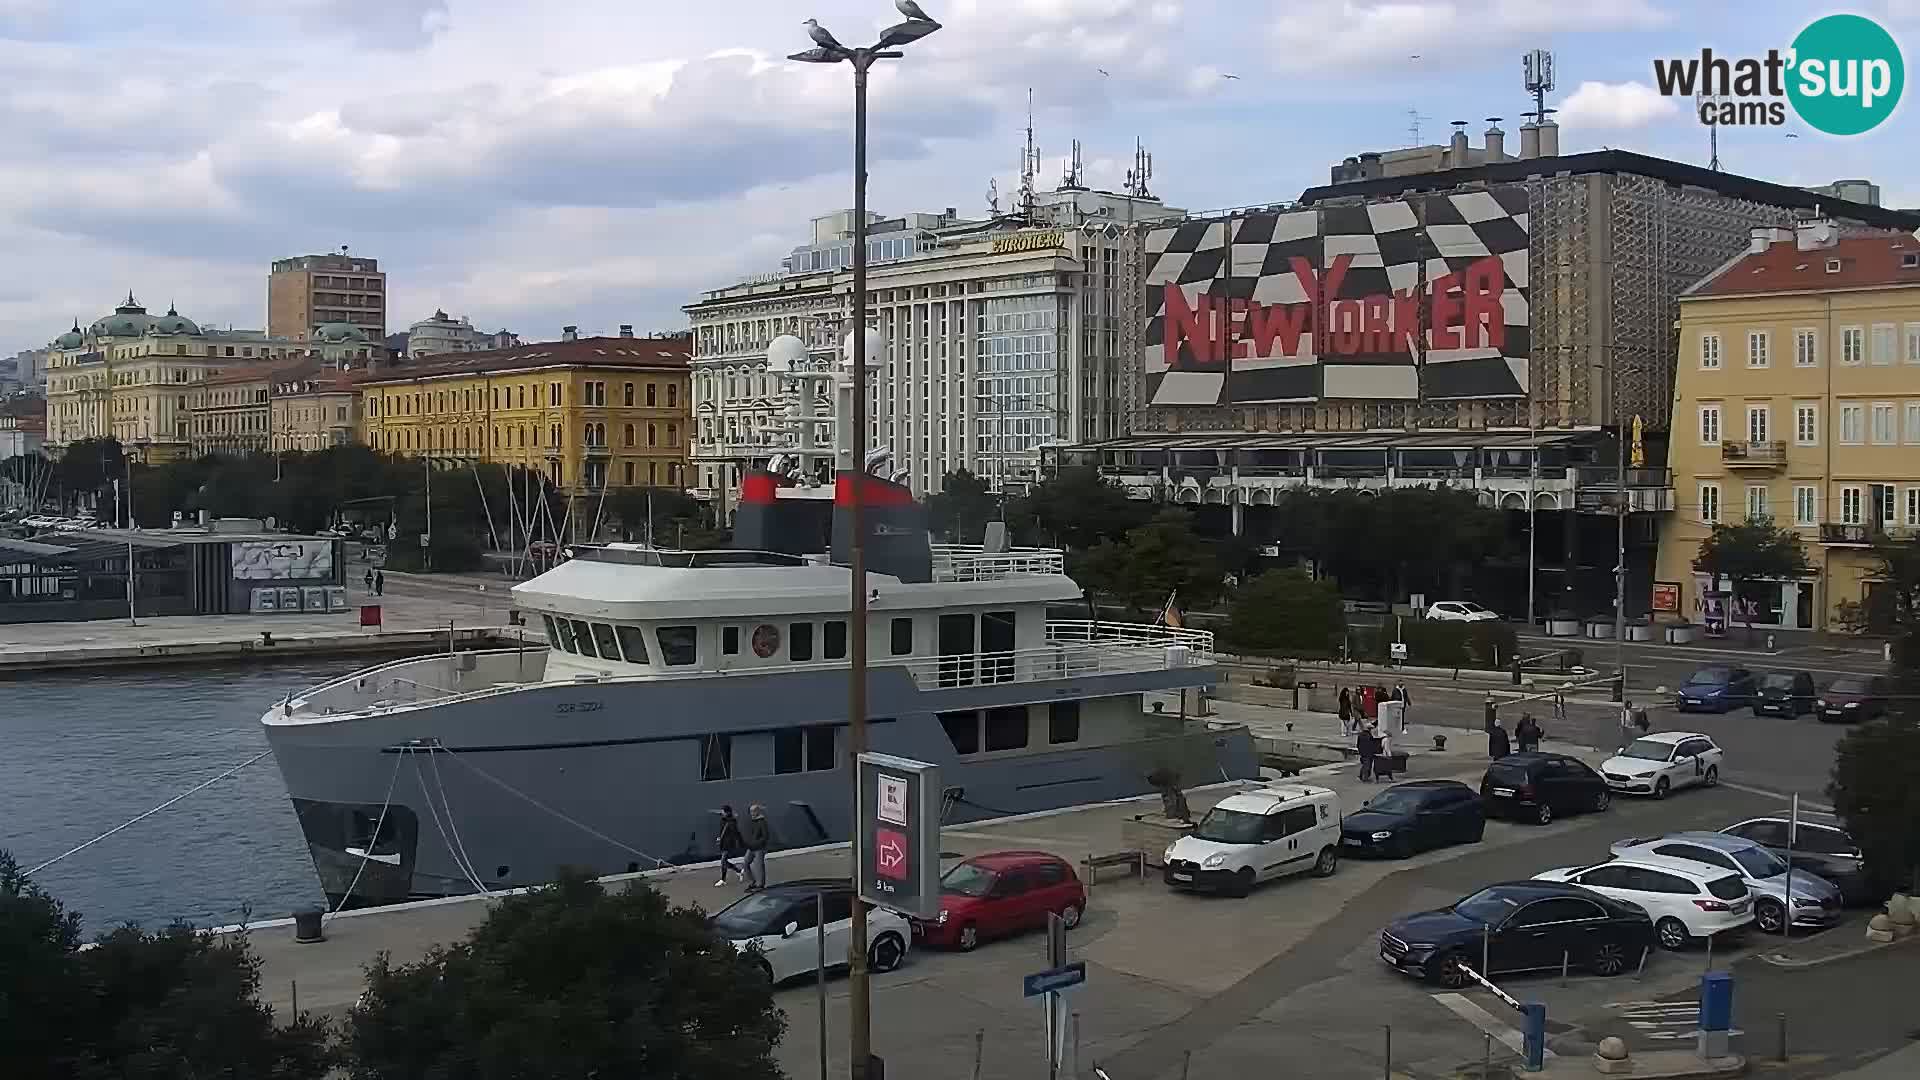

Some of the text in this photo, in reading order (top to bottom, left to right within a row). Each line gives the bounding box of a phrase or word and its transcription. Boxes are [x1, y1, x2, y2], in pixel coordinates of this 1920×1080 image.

[1164, 254, 1505, 364] NEW YORKER
[883, 881, 895, 893] km
